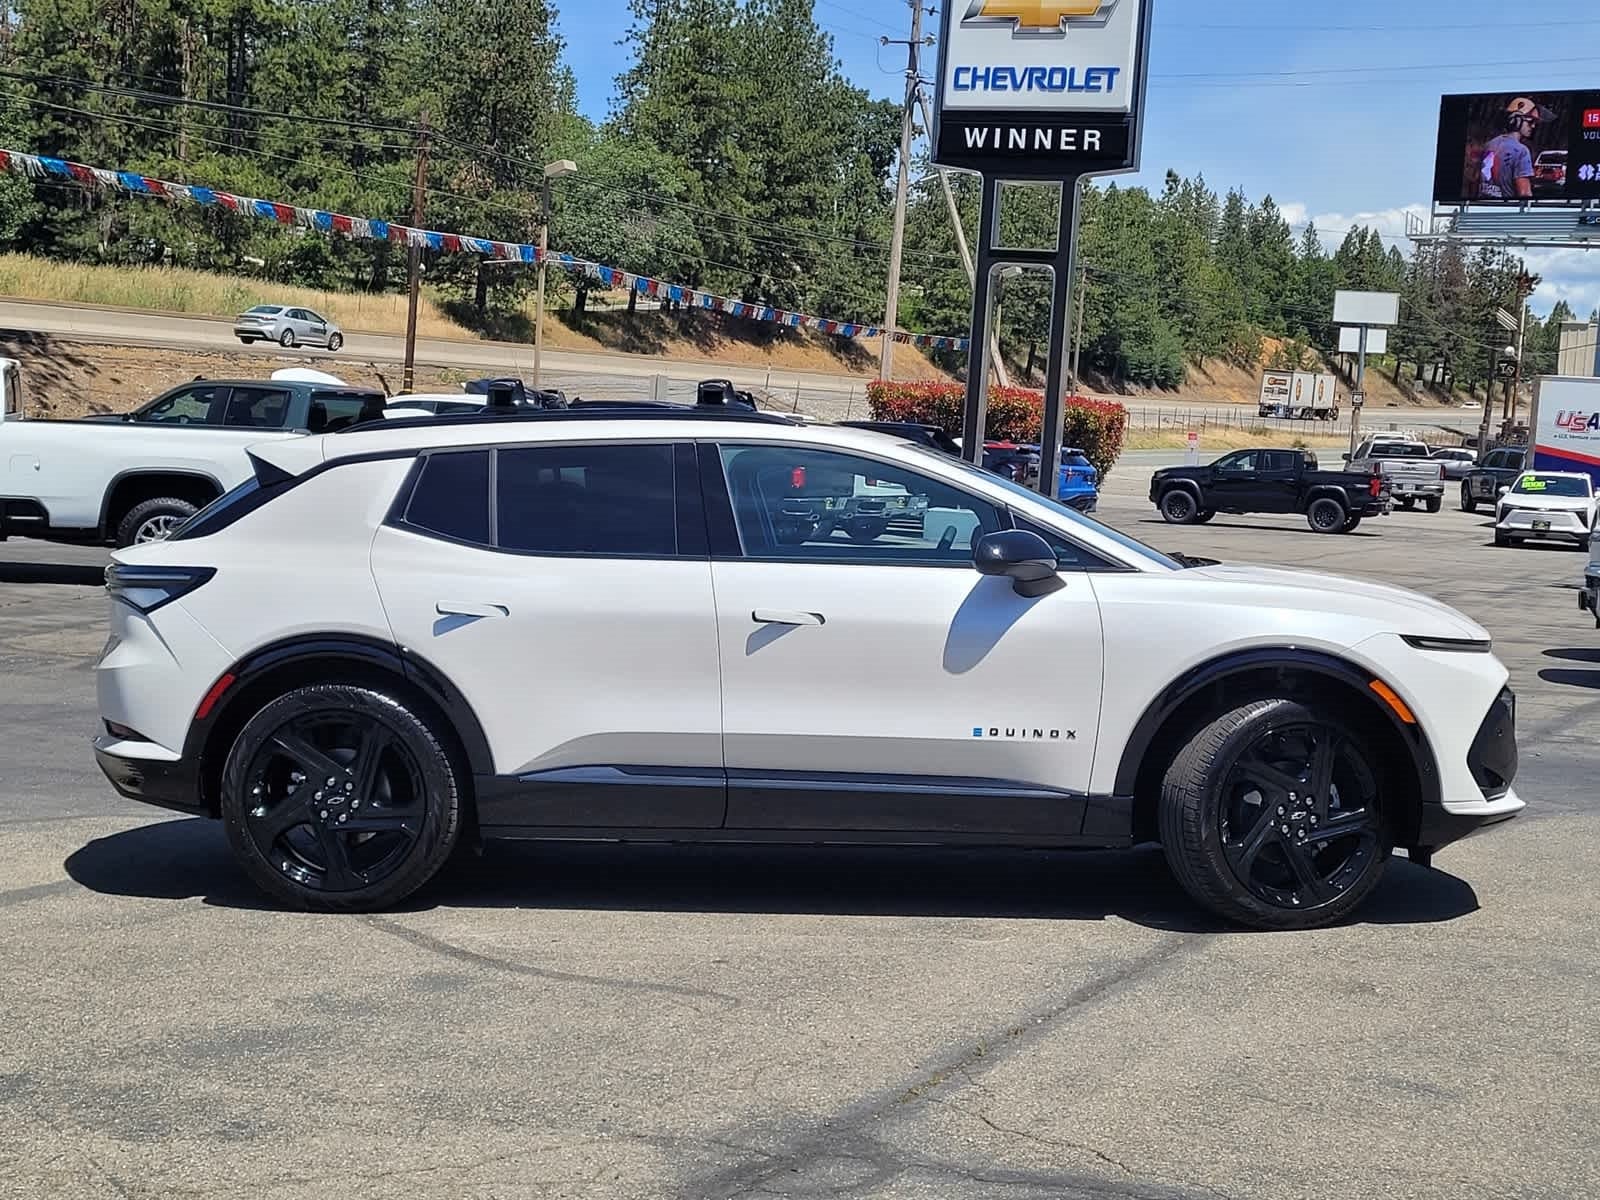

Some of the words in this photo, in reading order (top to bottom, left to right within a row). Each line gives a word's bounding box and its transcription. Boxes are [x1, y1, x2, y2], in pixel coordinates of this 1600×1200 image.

[953, 66, 1120, 93] CHEVROLET
[964, 127, 1102, 150] WINNER
[972, 727, 1077, 740] EQUINOX
